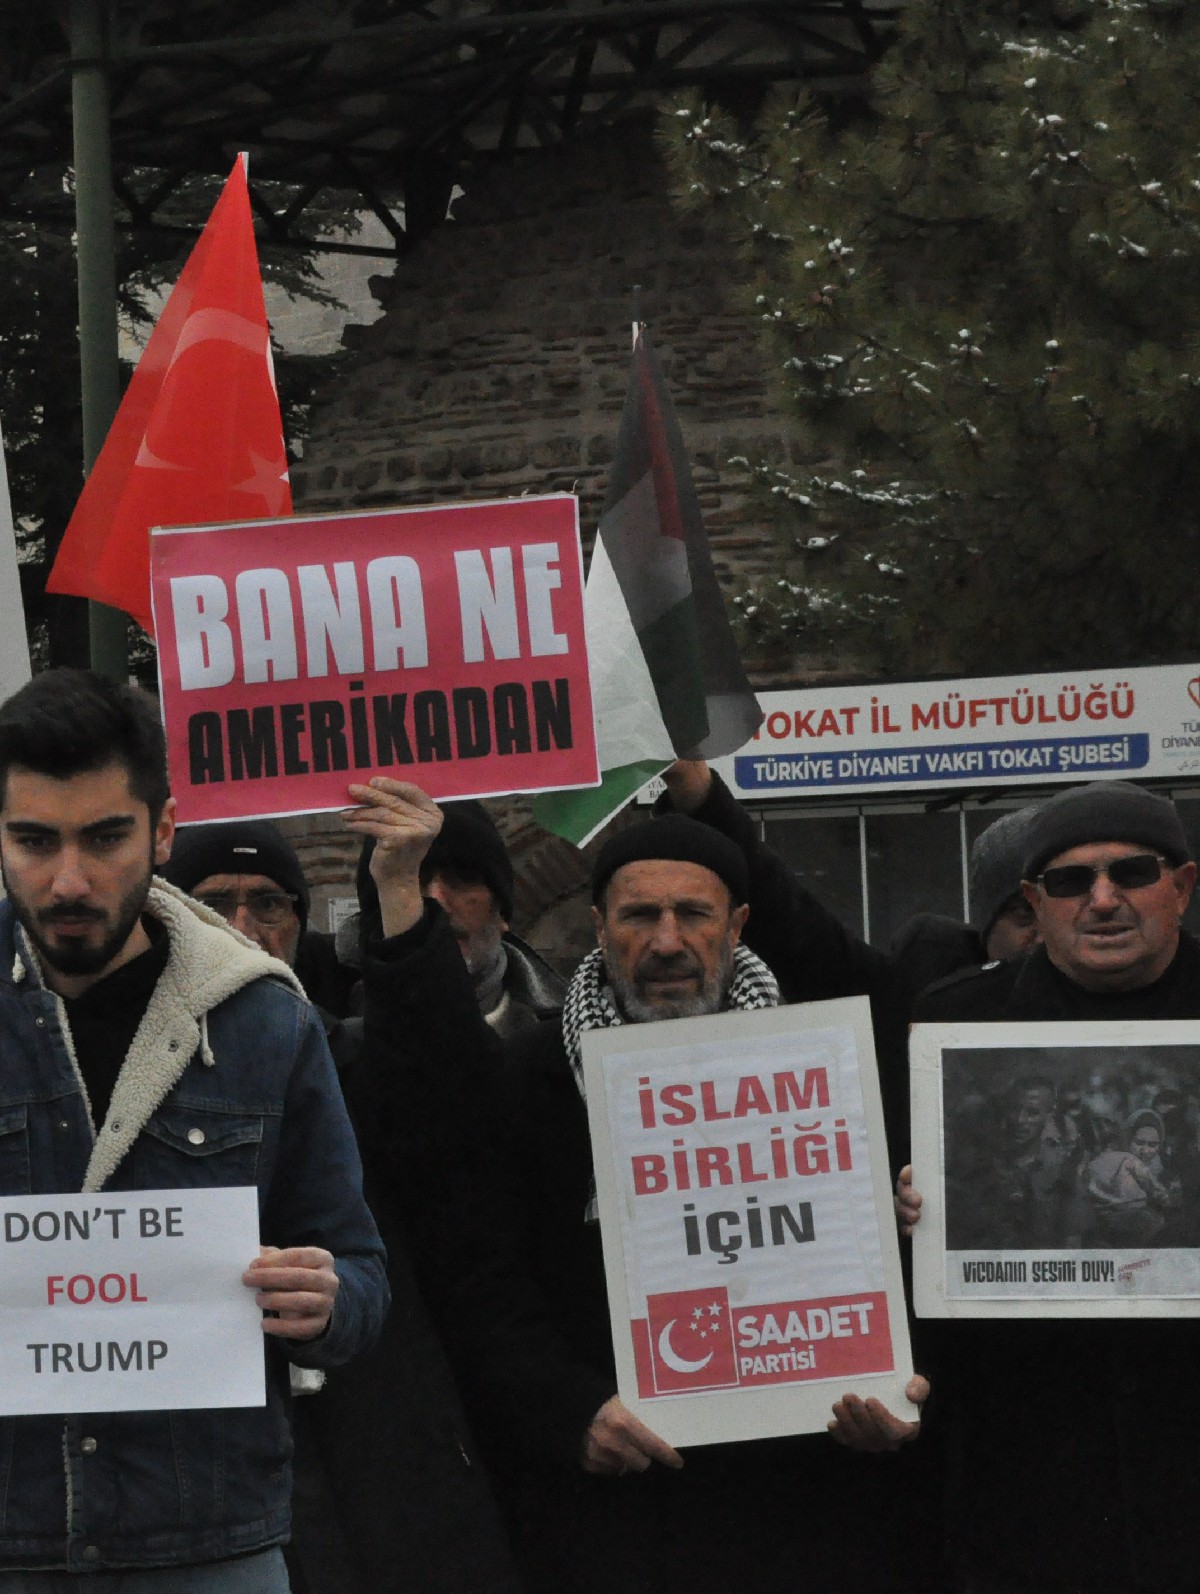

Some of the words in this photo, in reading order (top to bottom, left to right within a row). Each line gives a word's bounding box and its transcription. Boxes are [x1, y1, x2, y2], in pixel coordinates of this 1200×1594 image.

[169, 556, 429, 691] BANA
[453, 542, 569, 663] NE
[871, 696, 902, 735] İL
[911, 682, 1136, 731] MÜFTÜLÜĞÜ
[188, 679, 574, 785] AMERİKADAN
[753, 756, 833, 782] TÜRKİYE
[839, 748, 923, 778] DİYANET
[927, 747, 984, 773] VAKFI
[988, 743, 1054, 770] TOKAT
[1058, 736, 1130, 770] ŞUBESİ
[638, 1067, 830, 1128] İSLAM
[631, 1119, 853, 1196] BİRLİĞİ
[139, 1207, 184, 1238] BE
[683, 1196, 816, 1264] İÇİN
[47, 1273, 148, 1305] FOOL
[1082, 1260, 1115, 1282] DUY!
[738, 1303, 874, 1348] SAADET
[26, 1339, 169, 1374] TRUMP
[741, 1345, 816, 1376] PARTİSİ
